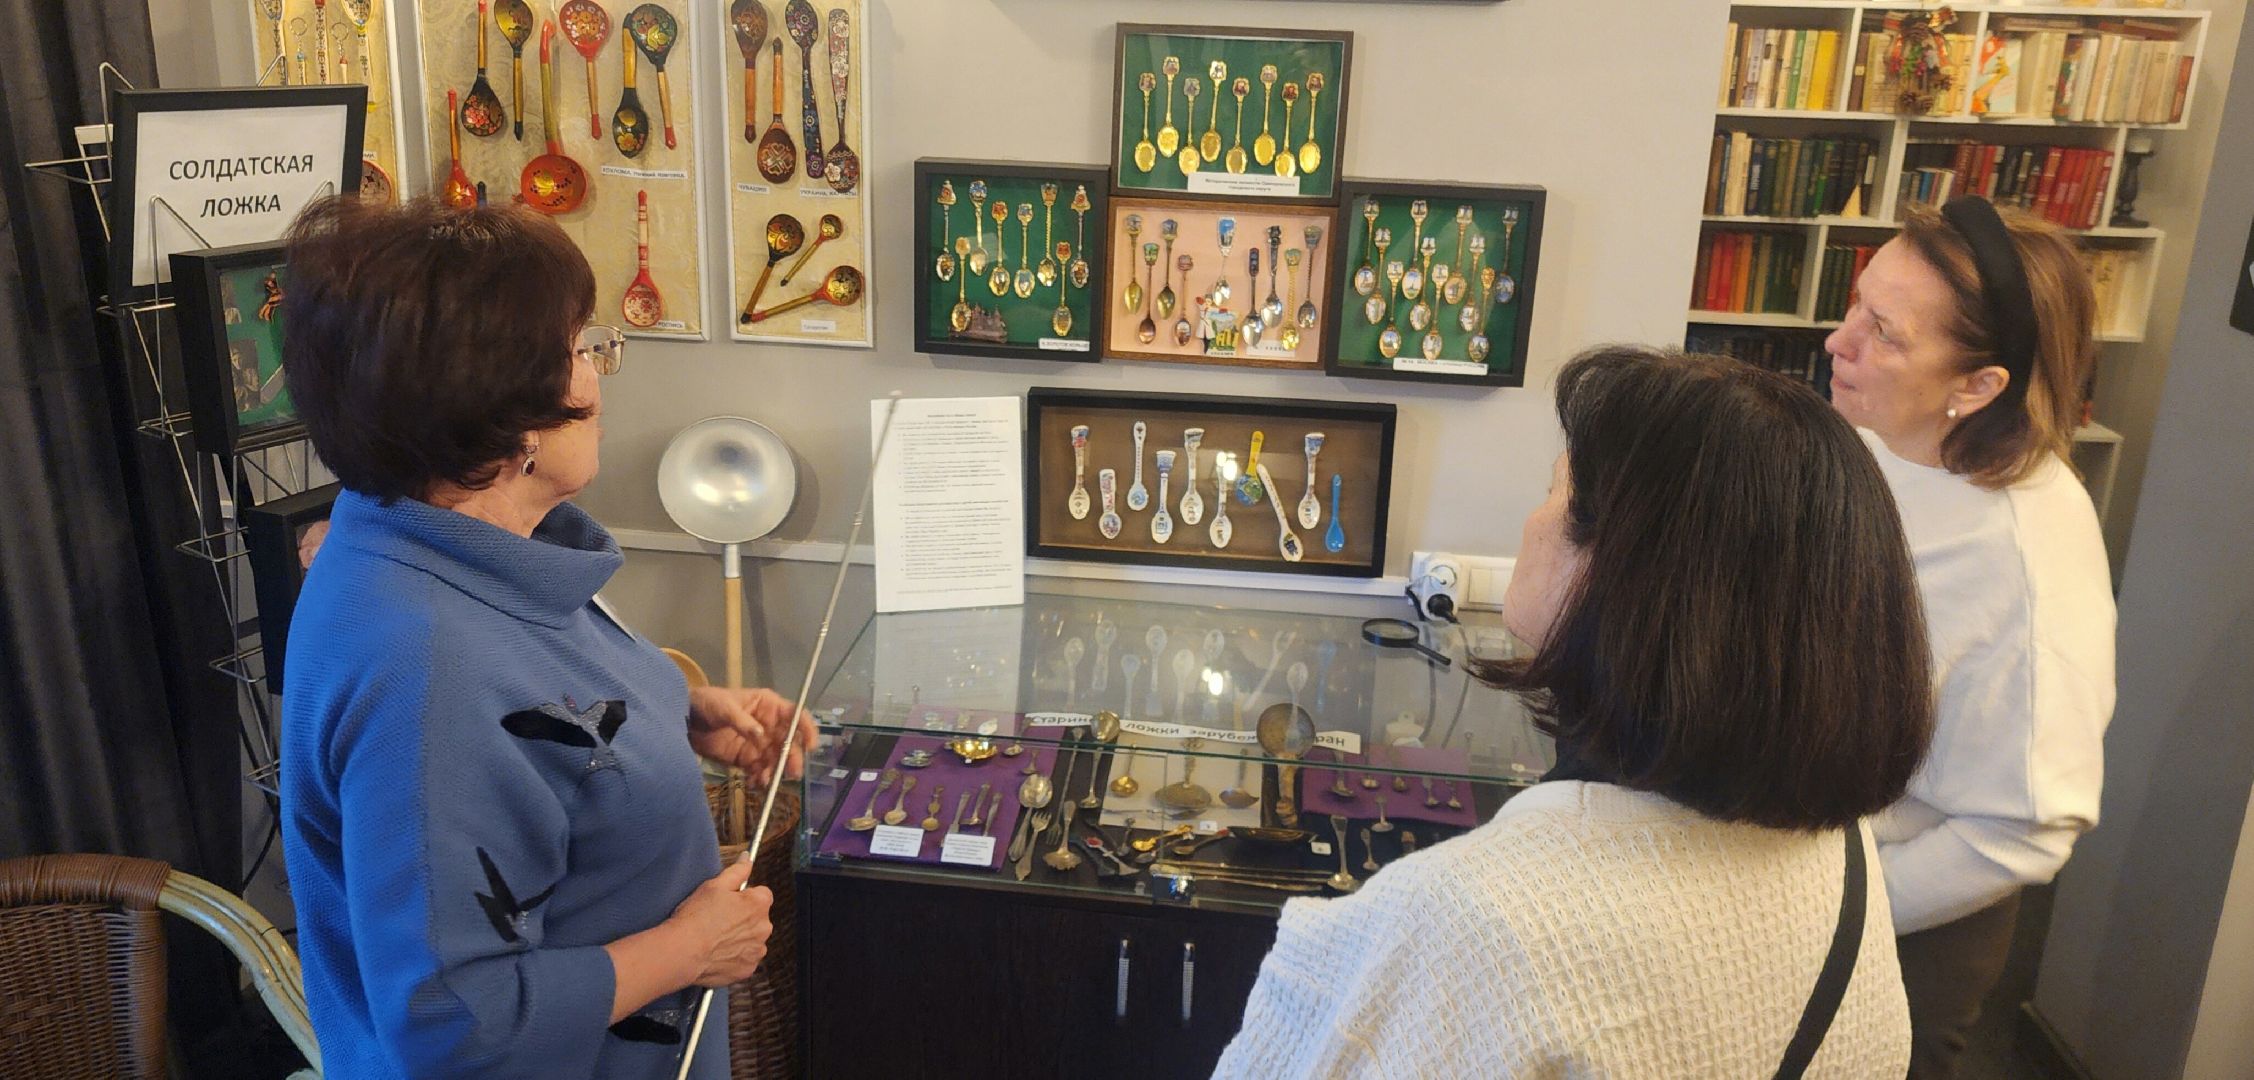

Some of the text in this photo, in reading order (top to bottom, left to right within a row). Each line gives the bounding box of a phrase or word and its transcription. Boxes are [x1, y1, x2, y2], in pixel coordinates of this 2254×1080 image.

[169, 154, 314, 183] СОЛДАТСКАЯ
[200, 194, 281, 218] ЛОЖКА
[1125, 723, 1180, 734] ложки
[1314, 735, 1345, 747] ран
